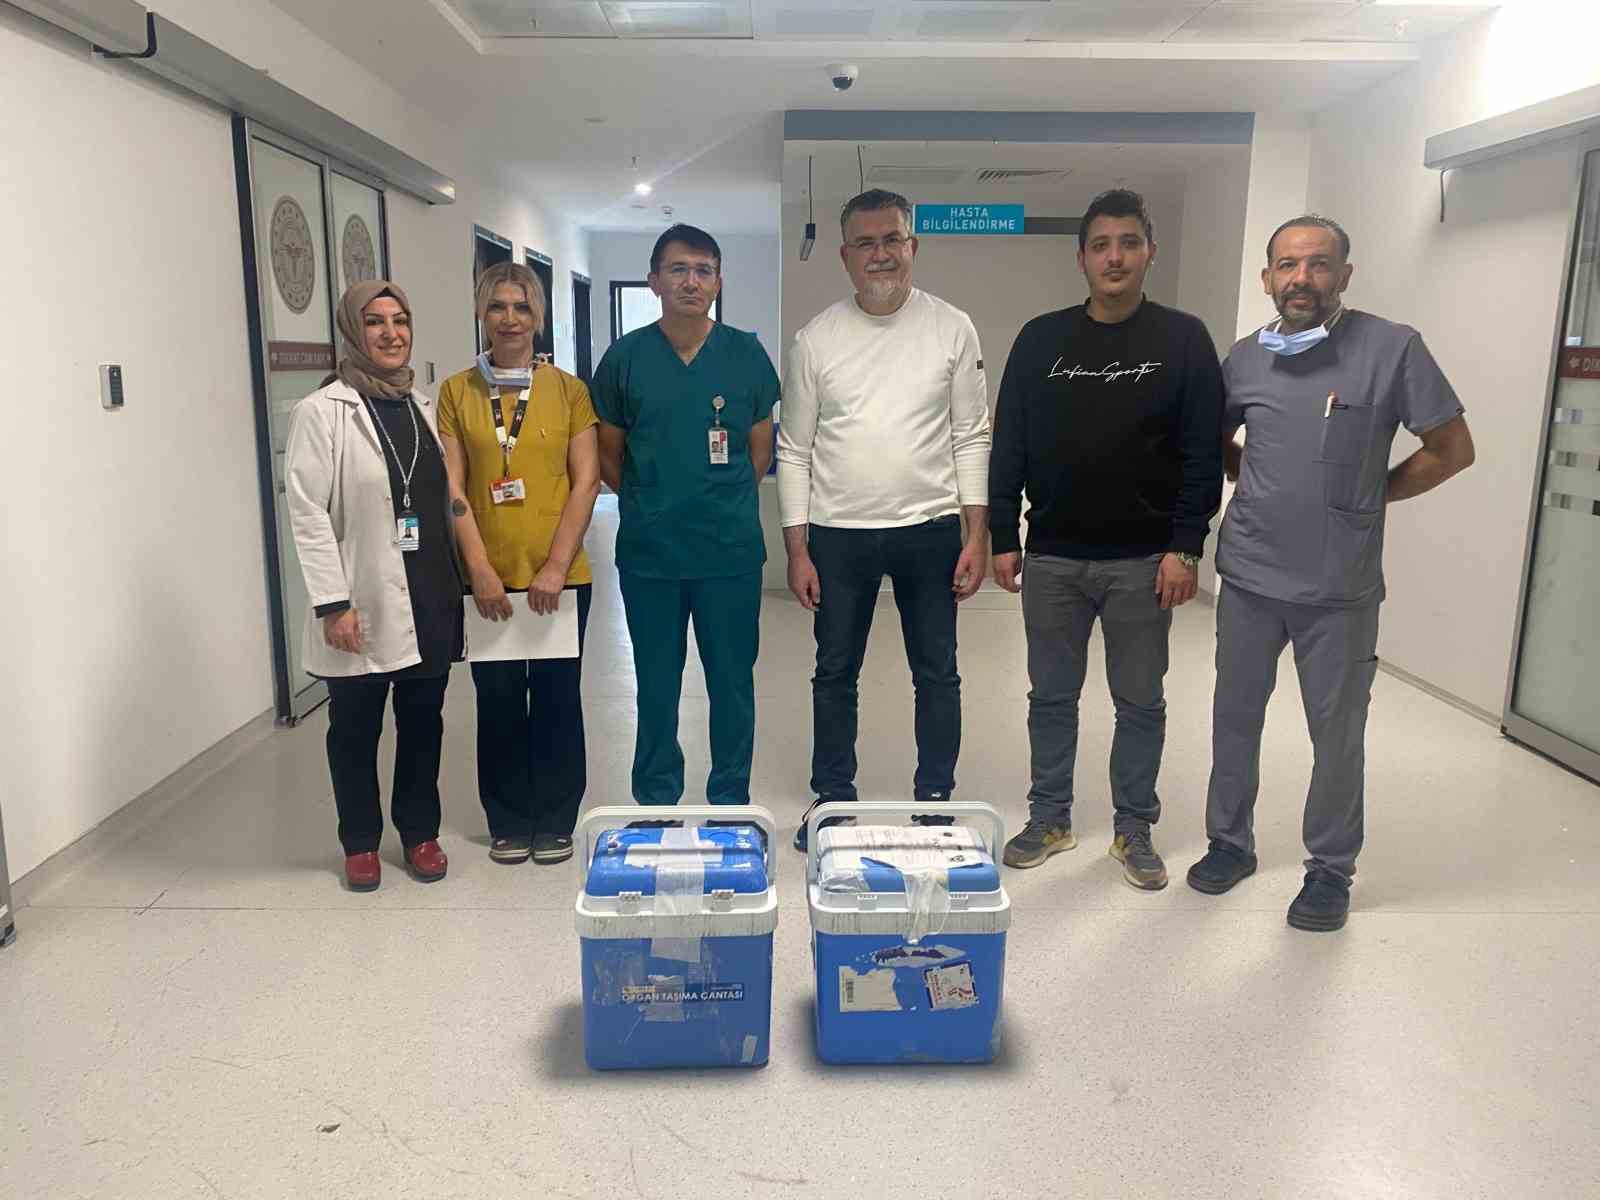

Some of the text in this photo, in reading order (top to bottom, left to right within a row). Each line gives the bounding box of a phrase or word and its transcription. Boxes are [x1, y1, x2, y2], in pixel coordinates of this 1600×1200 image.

[950, 207, 989, 217] HASTA
[922, 216, 1016, 230] BİLGİLENDİRME
[700, 991, 743, 1001] ÇANTASI
